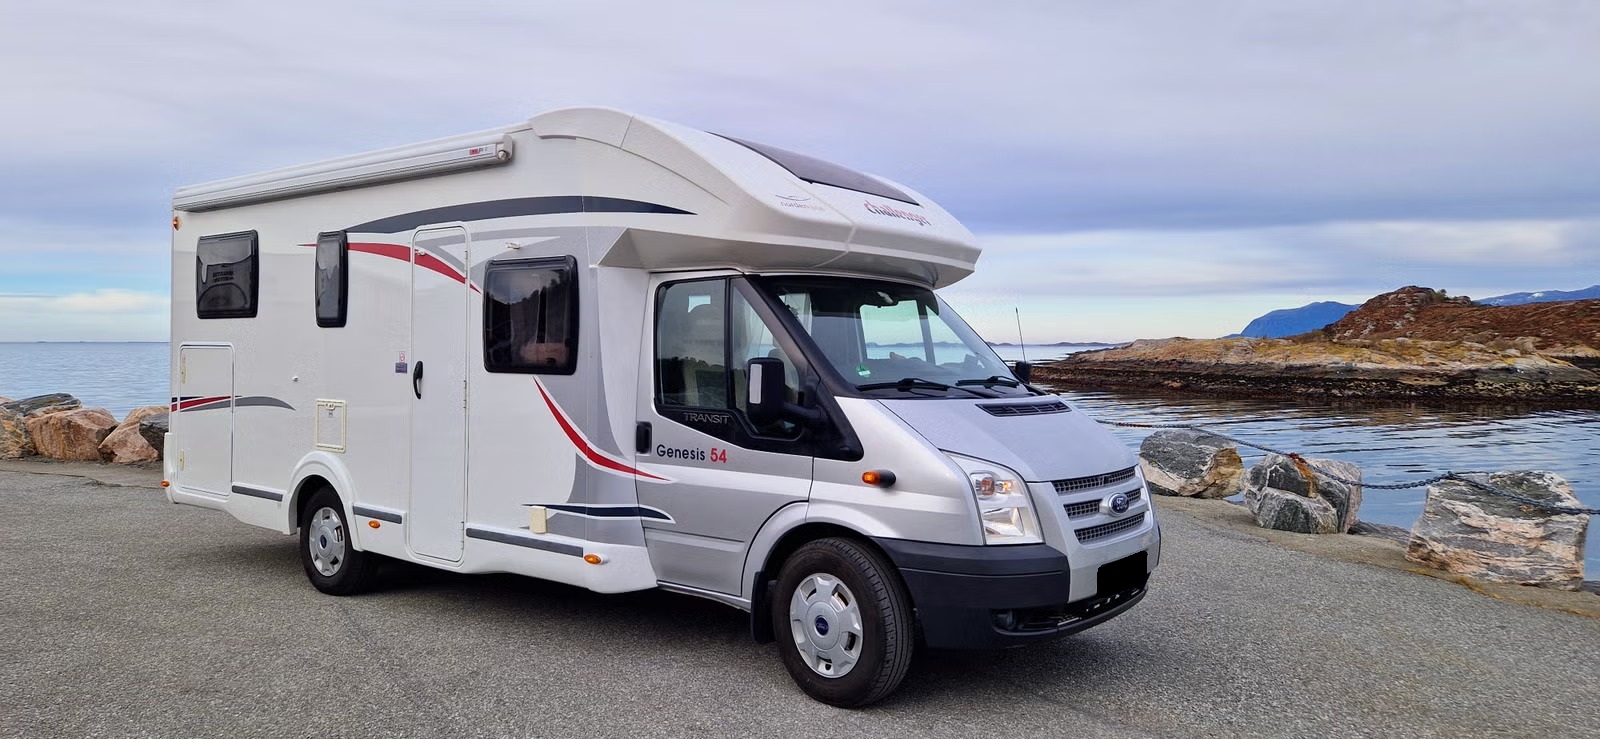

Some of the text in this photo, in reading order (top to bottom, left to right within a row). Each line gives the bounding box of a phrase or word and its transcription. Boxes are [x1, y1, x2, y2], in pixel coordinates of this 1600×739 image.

[683, 412, 729, 424] TRANSIT
[656, 444, 728, 464] Genesis 54
